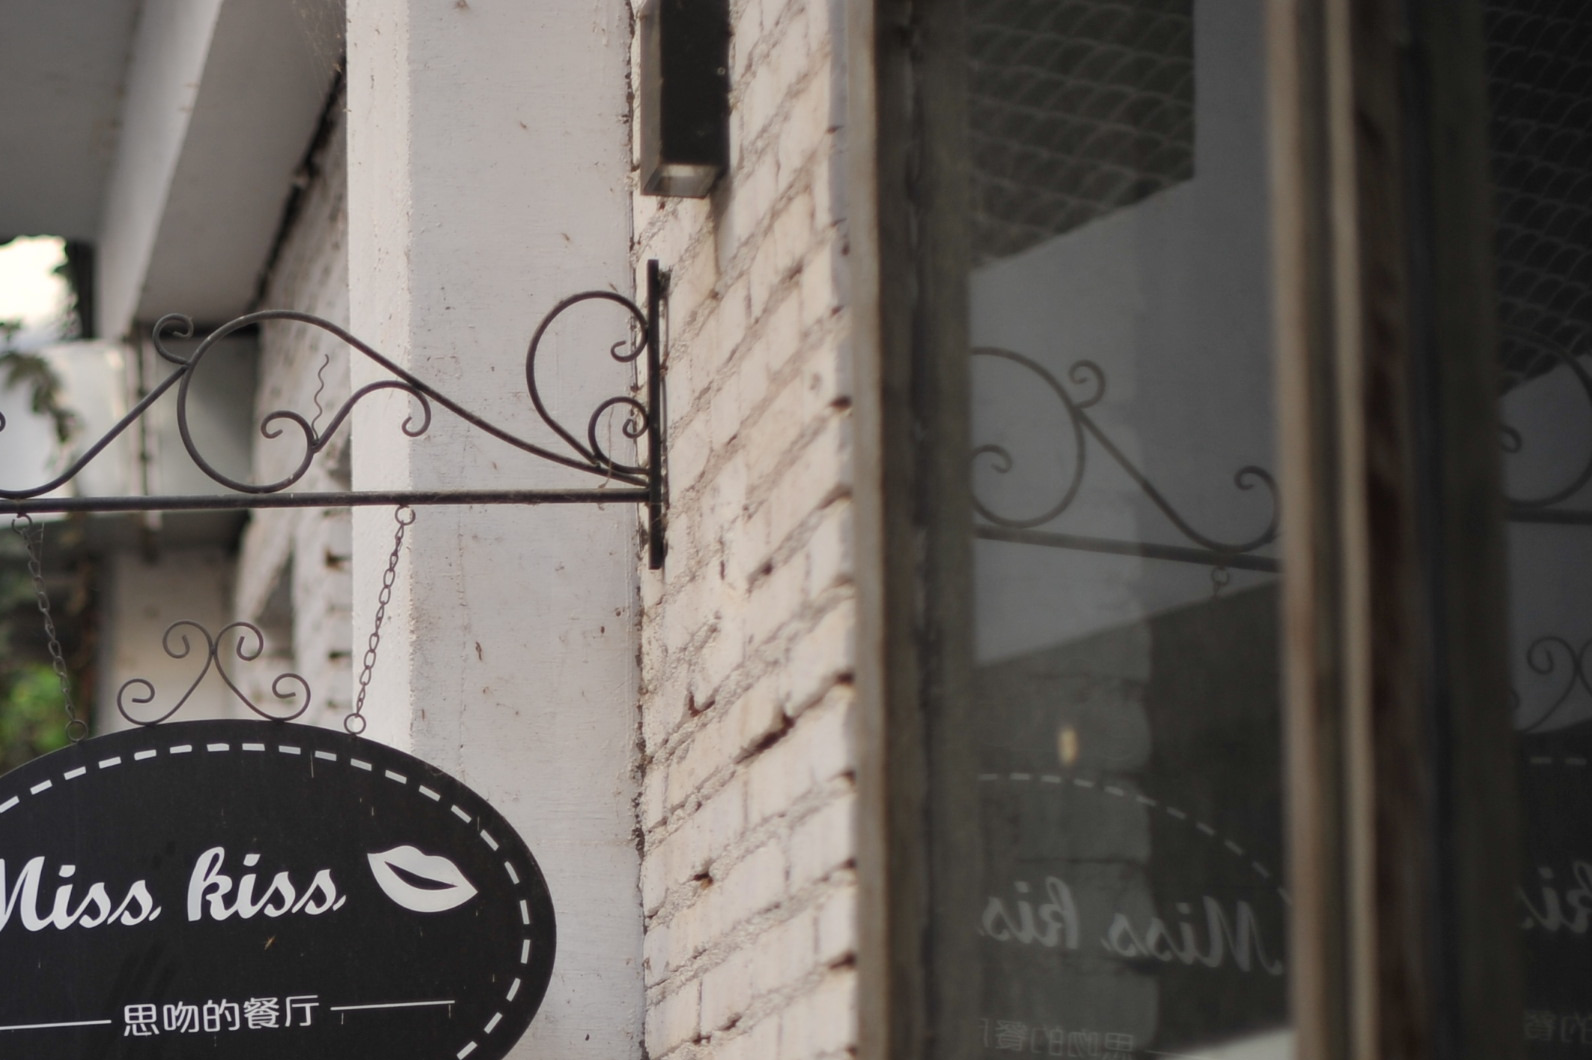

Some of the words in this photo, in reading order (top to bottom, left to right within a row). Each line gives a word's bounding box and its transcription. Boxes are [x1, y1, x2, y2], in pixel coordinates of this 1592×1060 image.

[187, 846, 346, 922] kiss
[123, 994, 320, 1037] 思吻的餐厅
